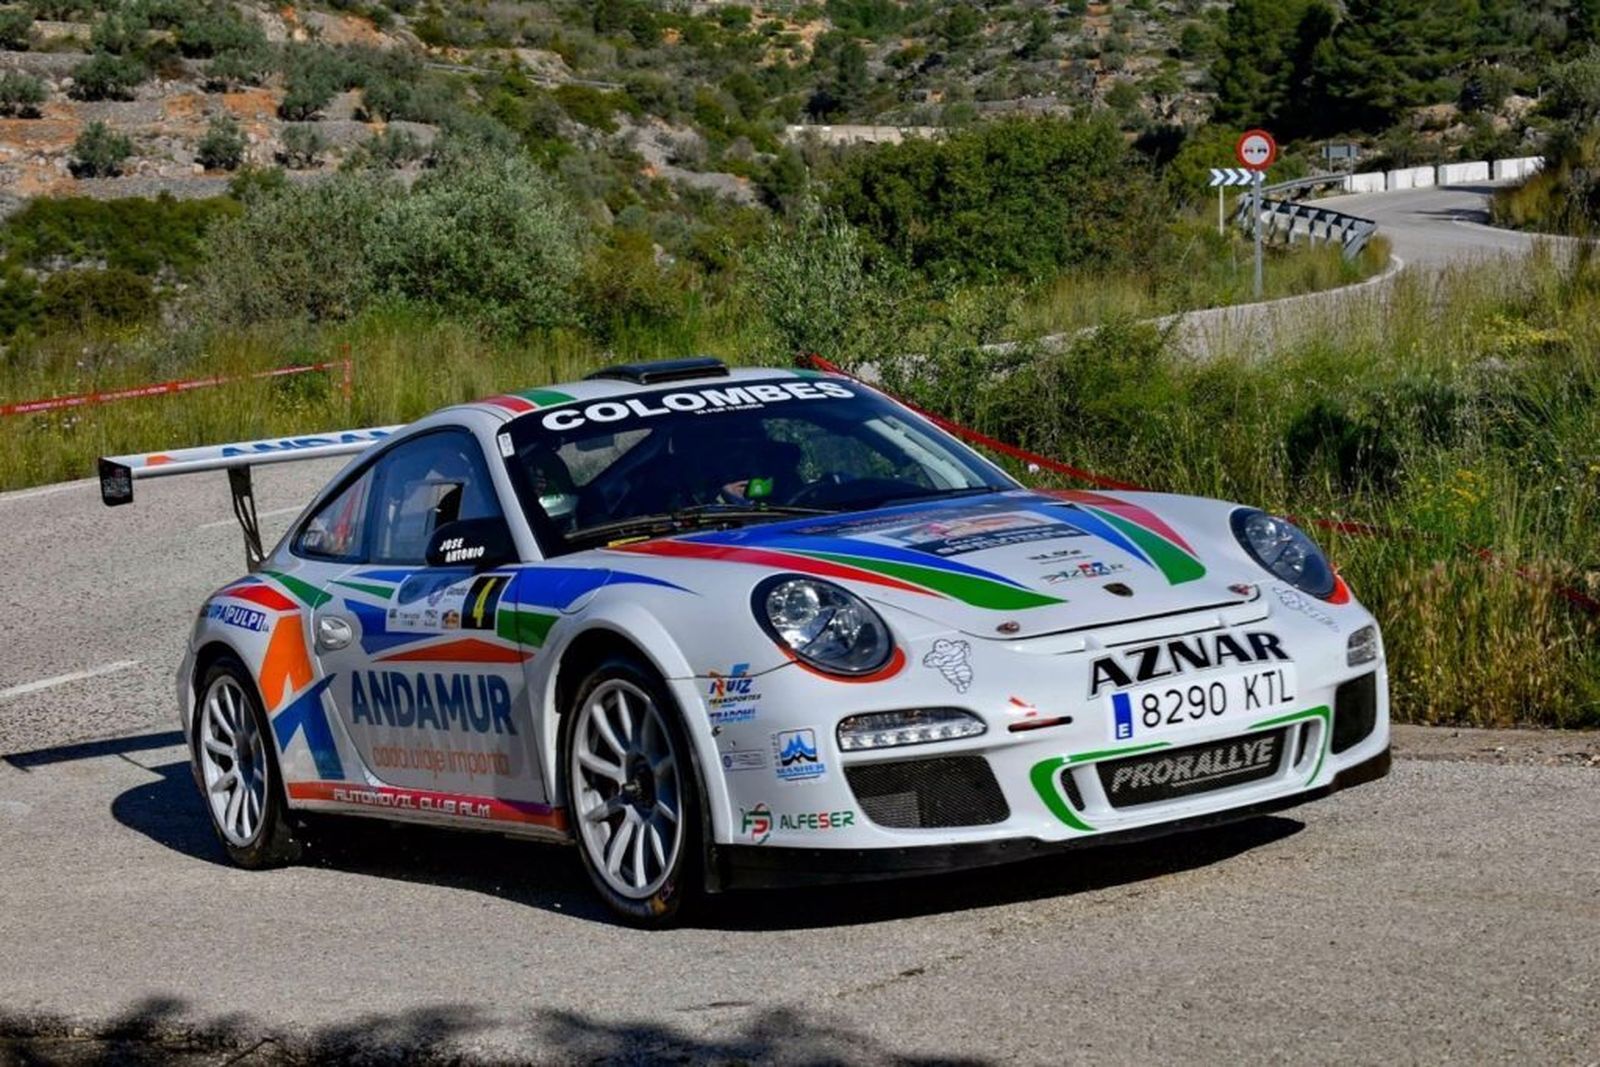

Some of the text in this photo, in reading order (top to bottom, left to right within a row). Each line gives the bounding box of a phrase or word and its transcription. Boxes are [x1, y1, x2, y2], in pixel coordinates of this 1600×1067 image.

[541, 381, 857, 431] COLOMBES
[439, 537, 464, 552] JOSE
[445, 546, 485, 563] ANTONIO
[472, 577, 497, 629] 4
[1090, 632, 1290, 696] AZNAR
[352, 670, 519, 737] ANDAMUR
[708, 671, 753, 698] RUIZ
[1141, 669, 1295, 729] 8290 KTL
[1118, 723, 1130, 738] E
[1111, 736, 1277, 793] PRORALLYE
[334, 788, 491, 818] AUTOMOVIL CLUB ALM
[780, 810, 855, 829] ALFESER
